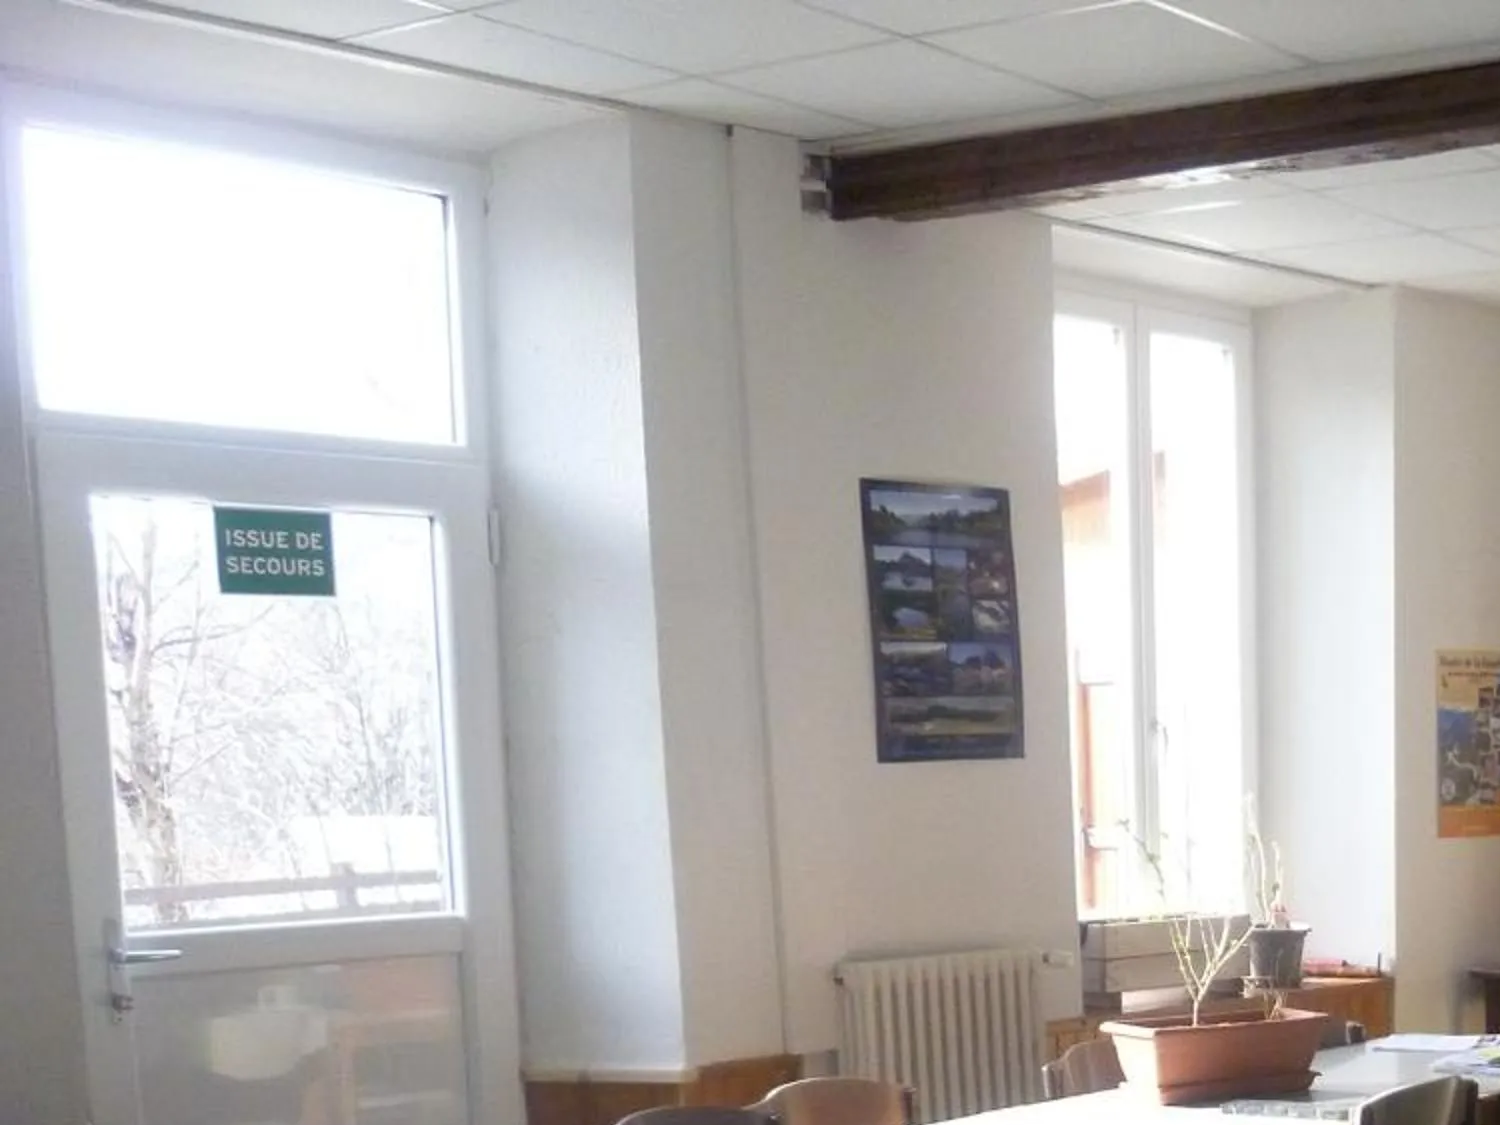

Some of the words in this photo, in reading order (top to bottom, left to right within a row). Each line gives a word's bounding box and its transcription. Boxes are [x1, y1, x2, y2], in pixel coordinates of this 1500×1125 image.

[225, 528, 289, 549] ISSUE
[295, 531, 324, 550] DE
[225, 556, 325, 576] SECOURS
